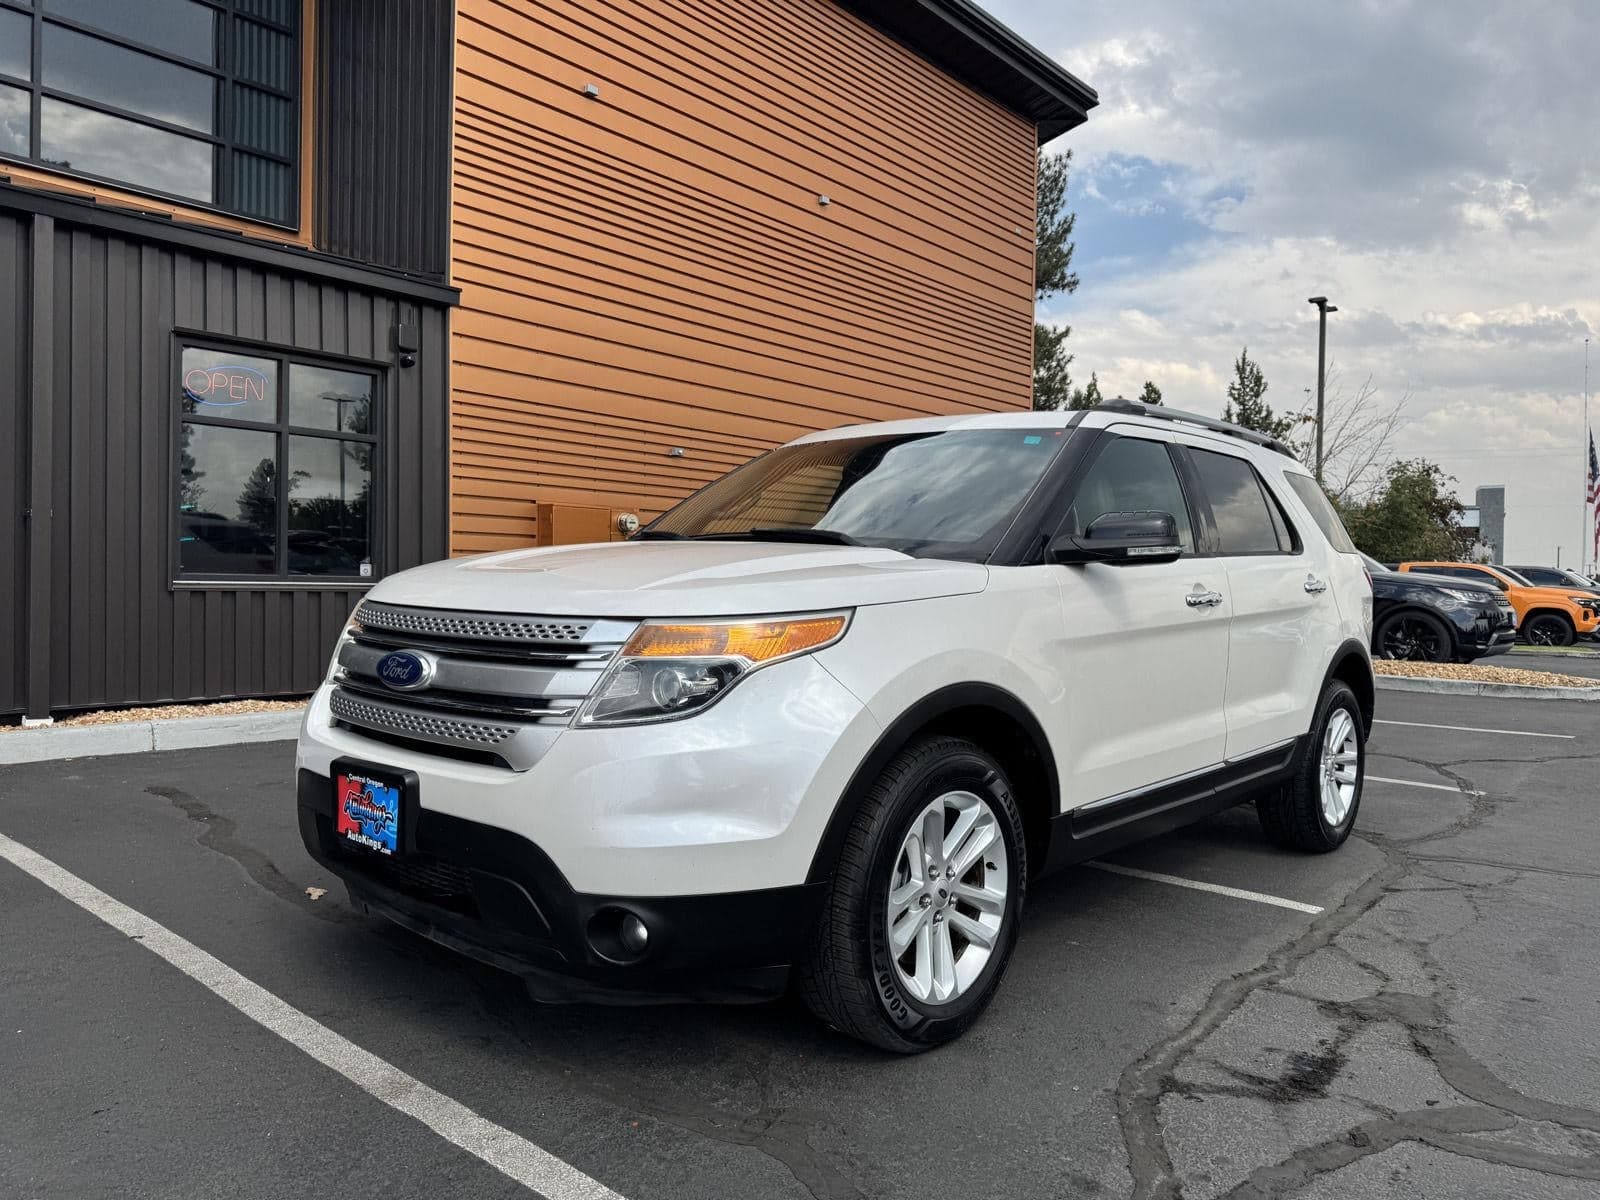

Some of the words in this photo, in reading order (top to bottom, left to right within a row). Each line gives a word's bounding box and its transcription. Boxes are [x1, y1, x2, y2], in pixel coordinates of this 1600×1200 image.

[185, 369, 264, 401] OPEN
[383, 656, 413, 679] Ford
[348, 773, 366, 784] Central
[366, 777, 384, 788] Oregon
